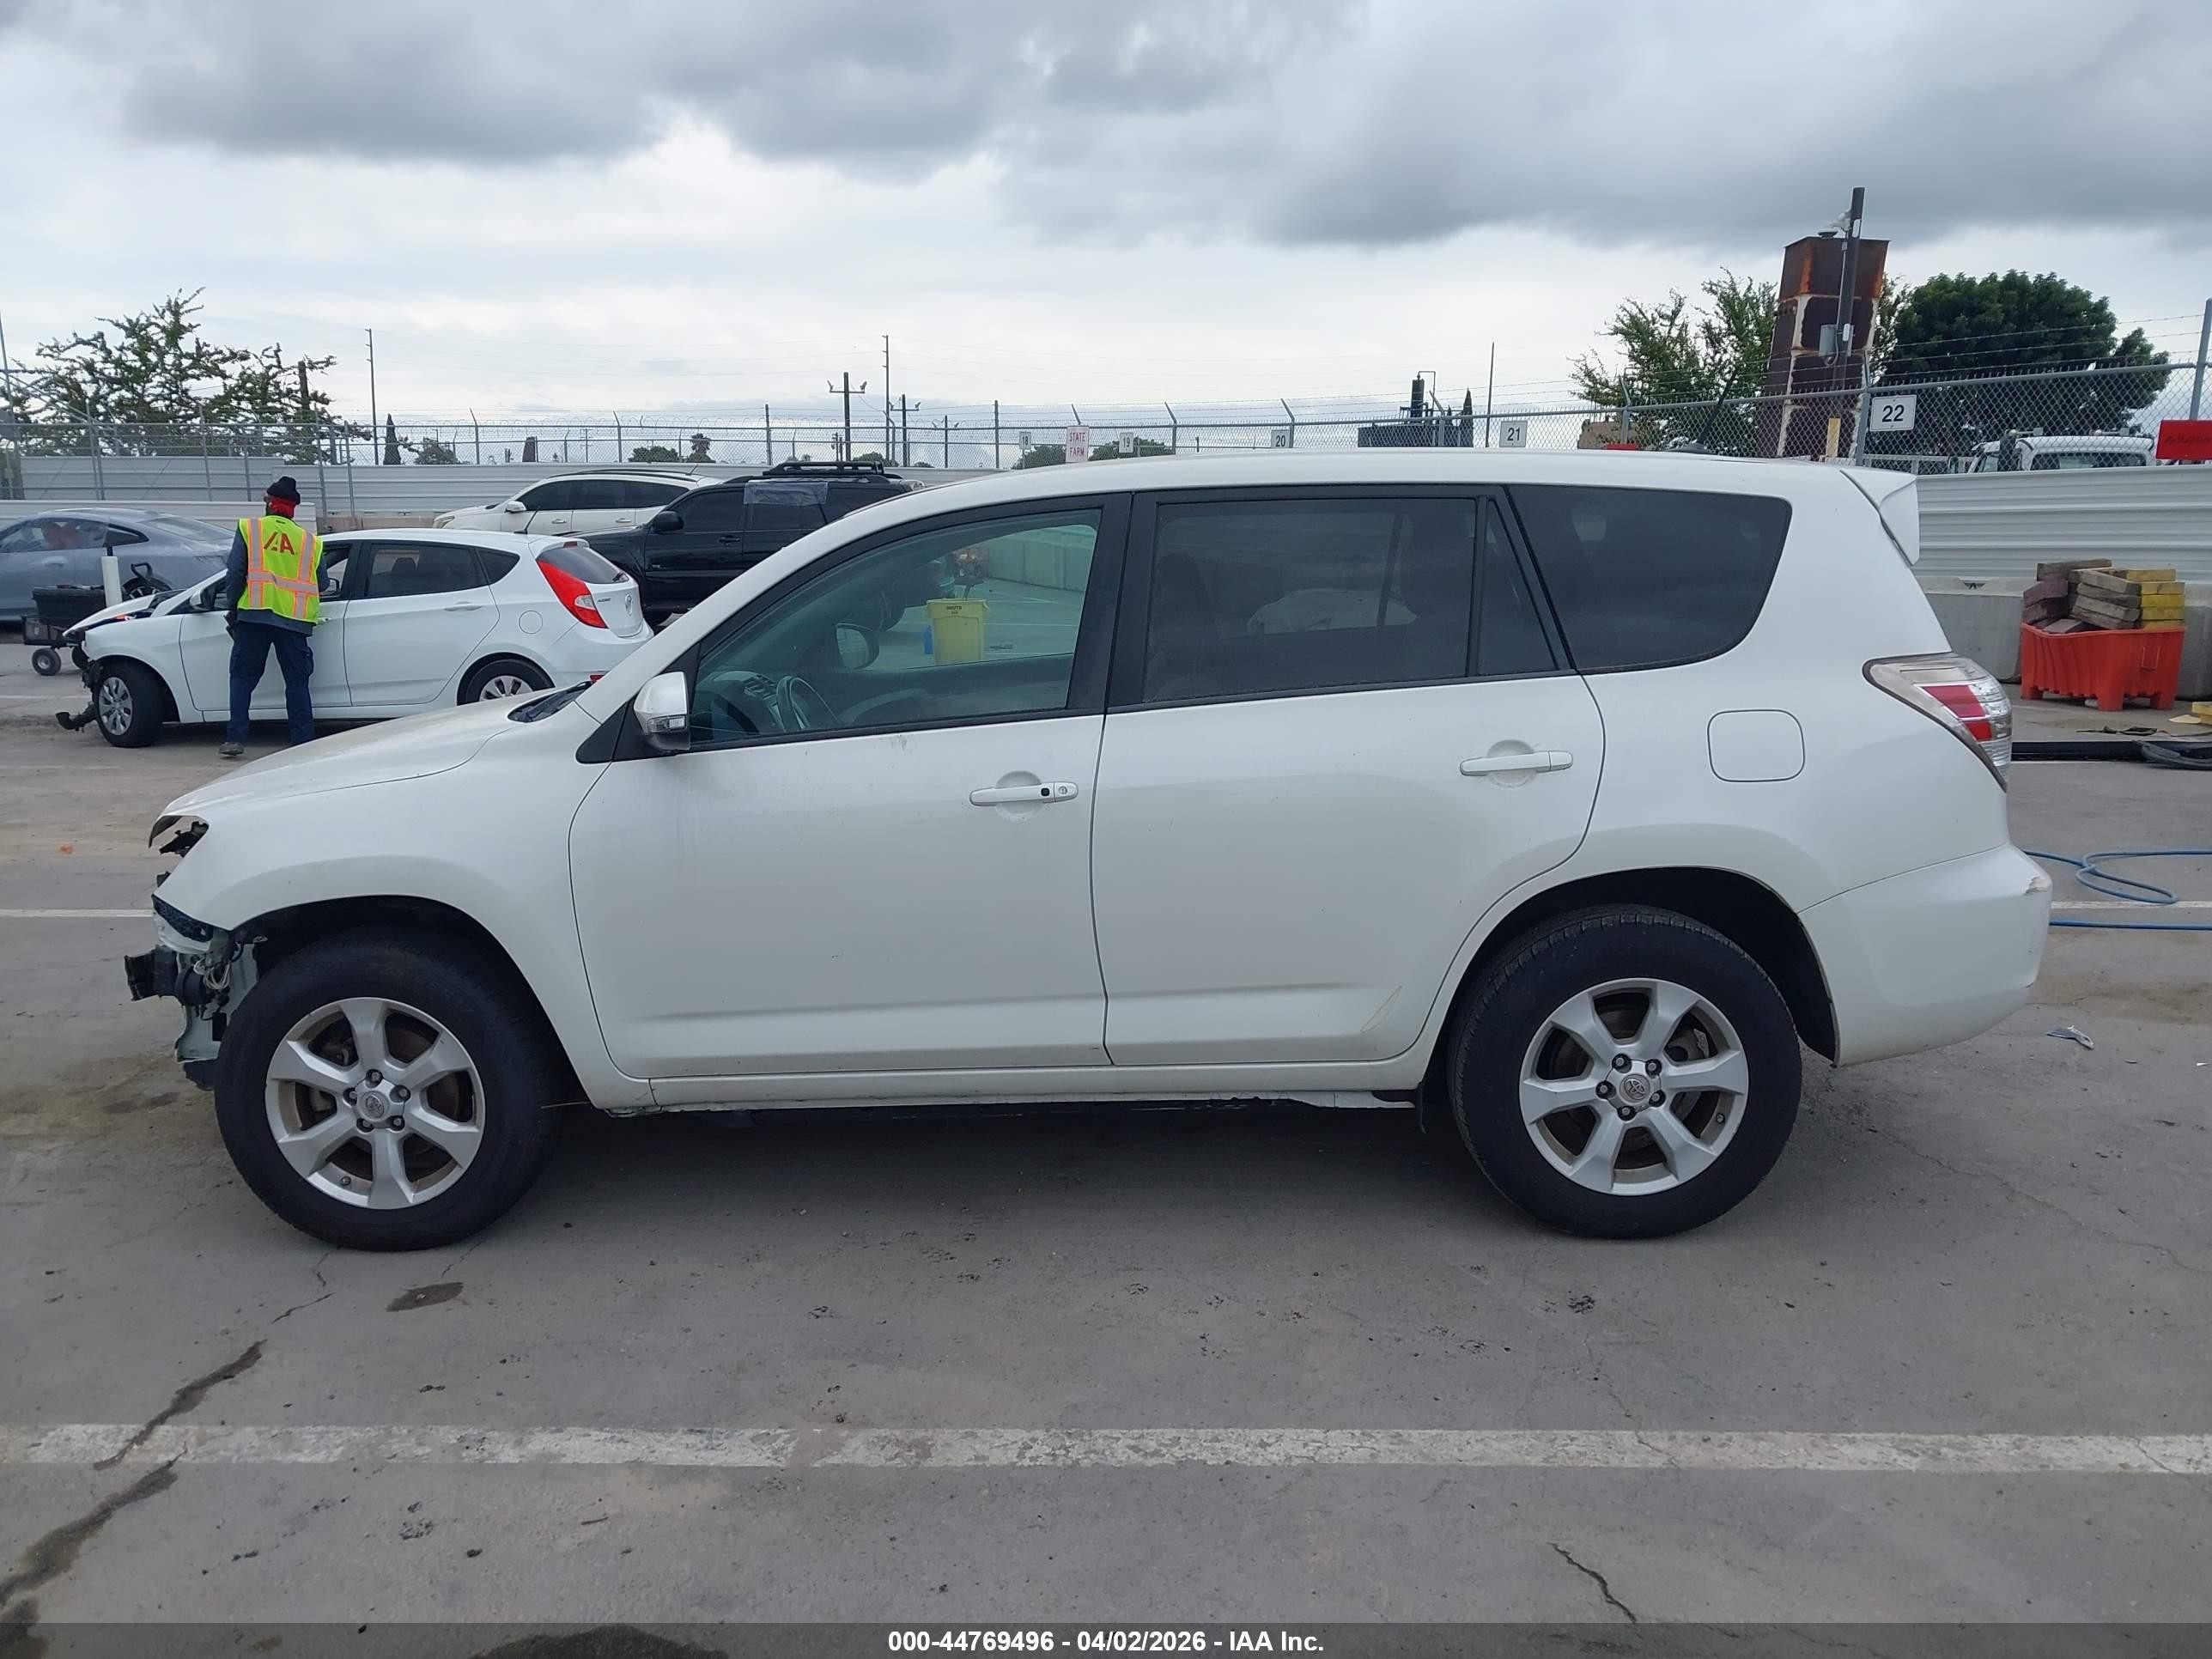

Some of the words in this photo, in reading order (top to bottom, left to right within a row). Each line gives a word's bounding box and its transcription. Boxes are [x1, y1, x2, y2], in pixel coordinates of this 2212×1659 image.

[1882, 404, 1905, 422] 22
[1069, 432, 1086, 442] STATE
[1507, 427, 1520, 441] 21
[1022, 435, 1029, 446] 18
[1123, 436, 1130, 447] 19
[1275, 434, 1286, 447] 20
[1069, 447, 1085, 457] FARM
